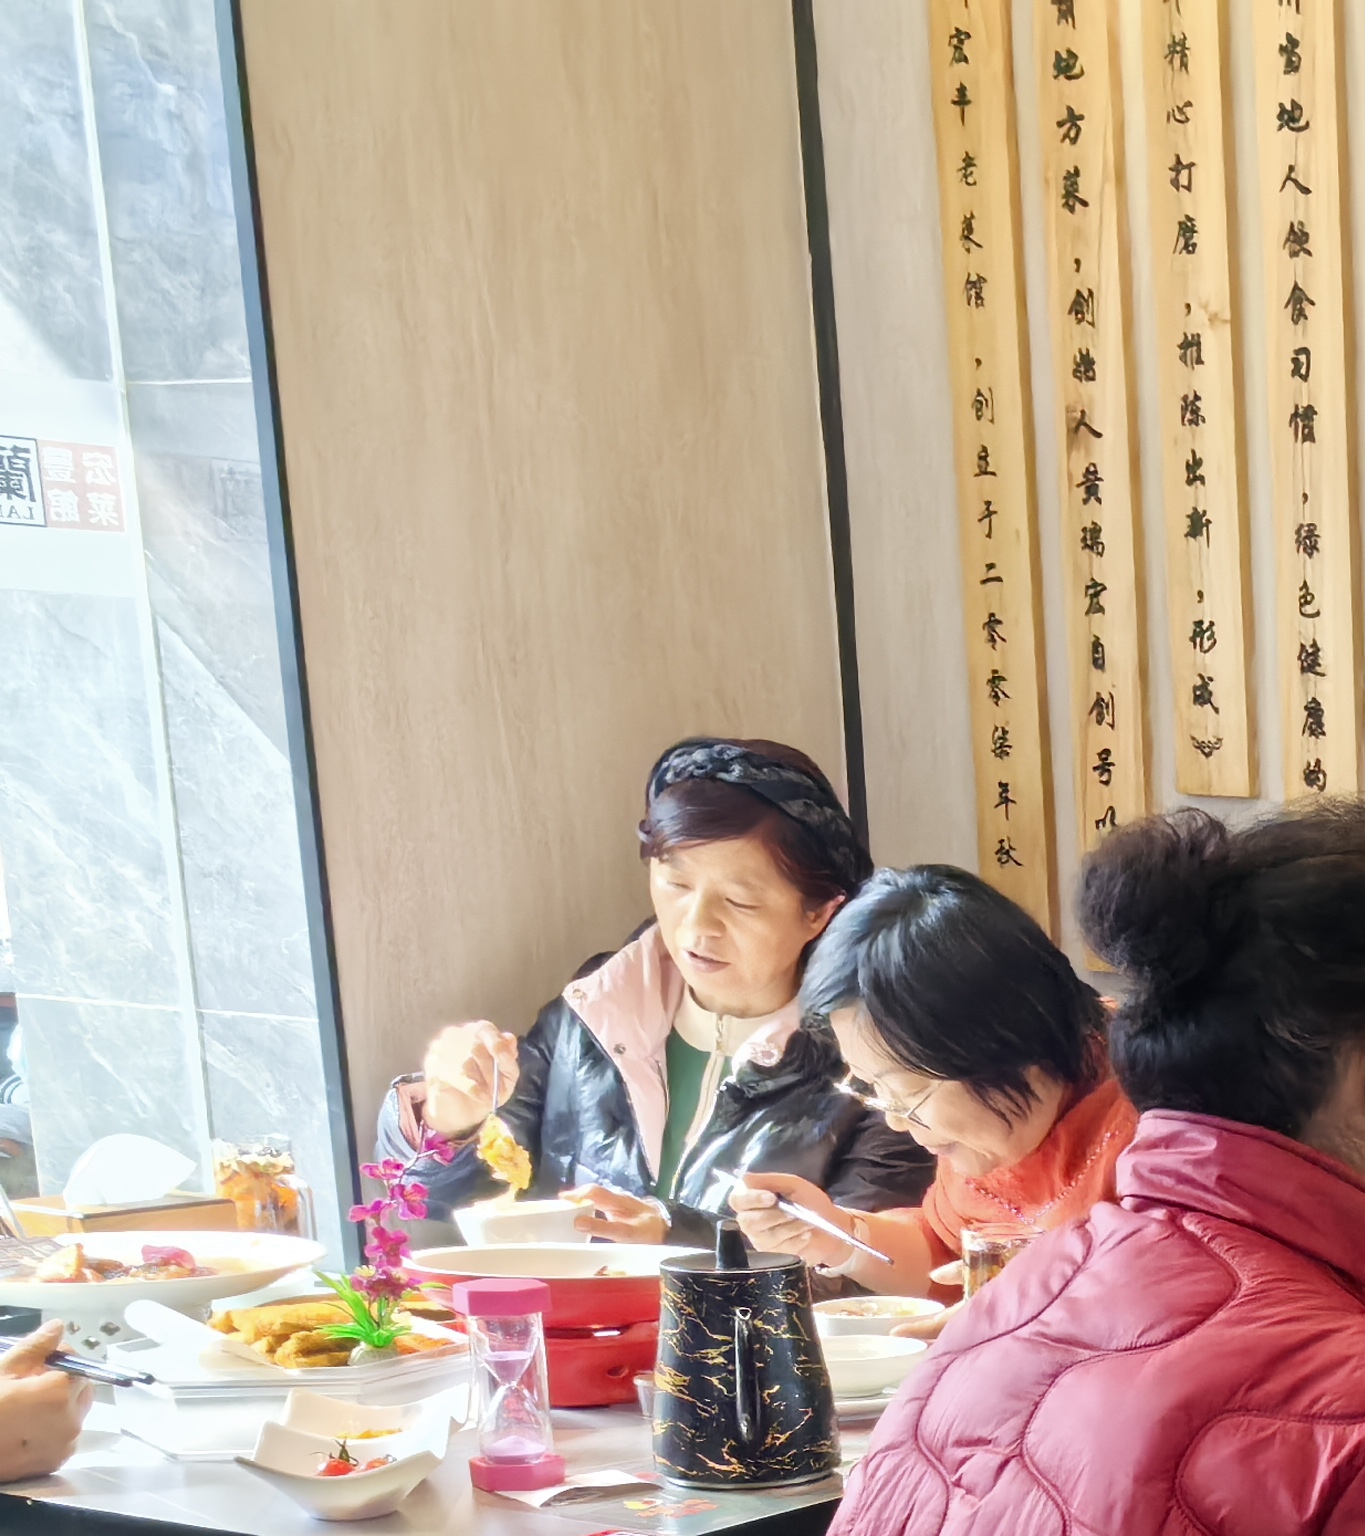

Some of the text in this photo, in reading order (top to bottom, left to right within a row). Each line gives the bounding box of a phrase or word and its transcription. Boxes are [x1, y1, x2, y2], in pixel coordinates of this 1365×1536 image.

[1164, 0, 1221, 715] 精心打磨,推陈出新,形成
